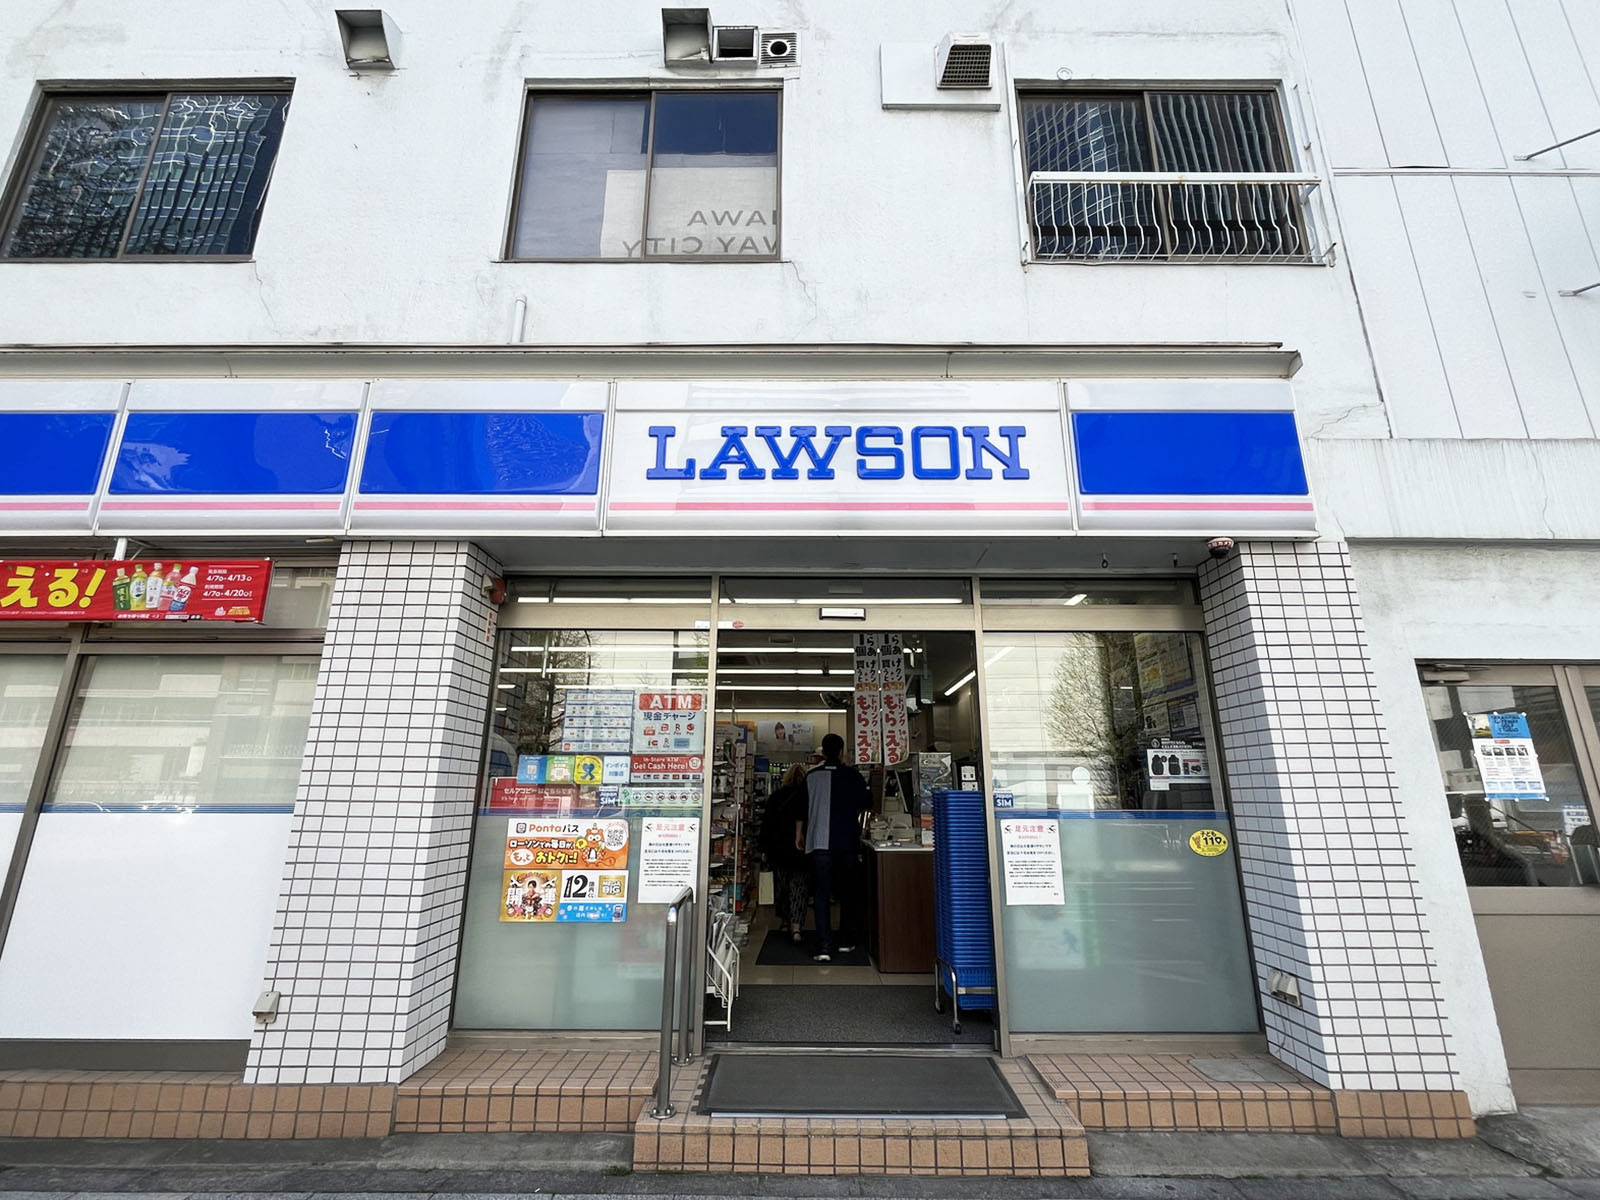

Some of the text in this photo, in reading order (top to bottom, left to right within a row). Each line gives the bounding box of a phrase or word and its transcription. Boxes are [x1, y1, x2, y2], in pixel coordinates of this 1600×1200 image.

[646, 426, 1030, 480] LAWSON
[0, 566, 106, 608] える!
[649, 695, 692, 709] ATM
[643, 711, 697, 721] 現金チャージ
[857, 694, 871, 763] もらえる
[884, 694, 899, 764] もらえる
[633, 762, 688, 770] Get Cash Here!
[600, 797, 616, 805] SIM
[996, 799, 1012, 807] SIM
[529, 824, 579, 834] Pontaパス
[512, 852, 531, 863] もっと
[535, 851, 578, 865] おトクに!
[602, 885, 622, 895] BIG
